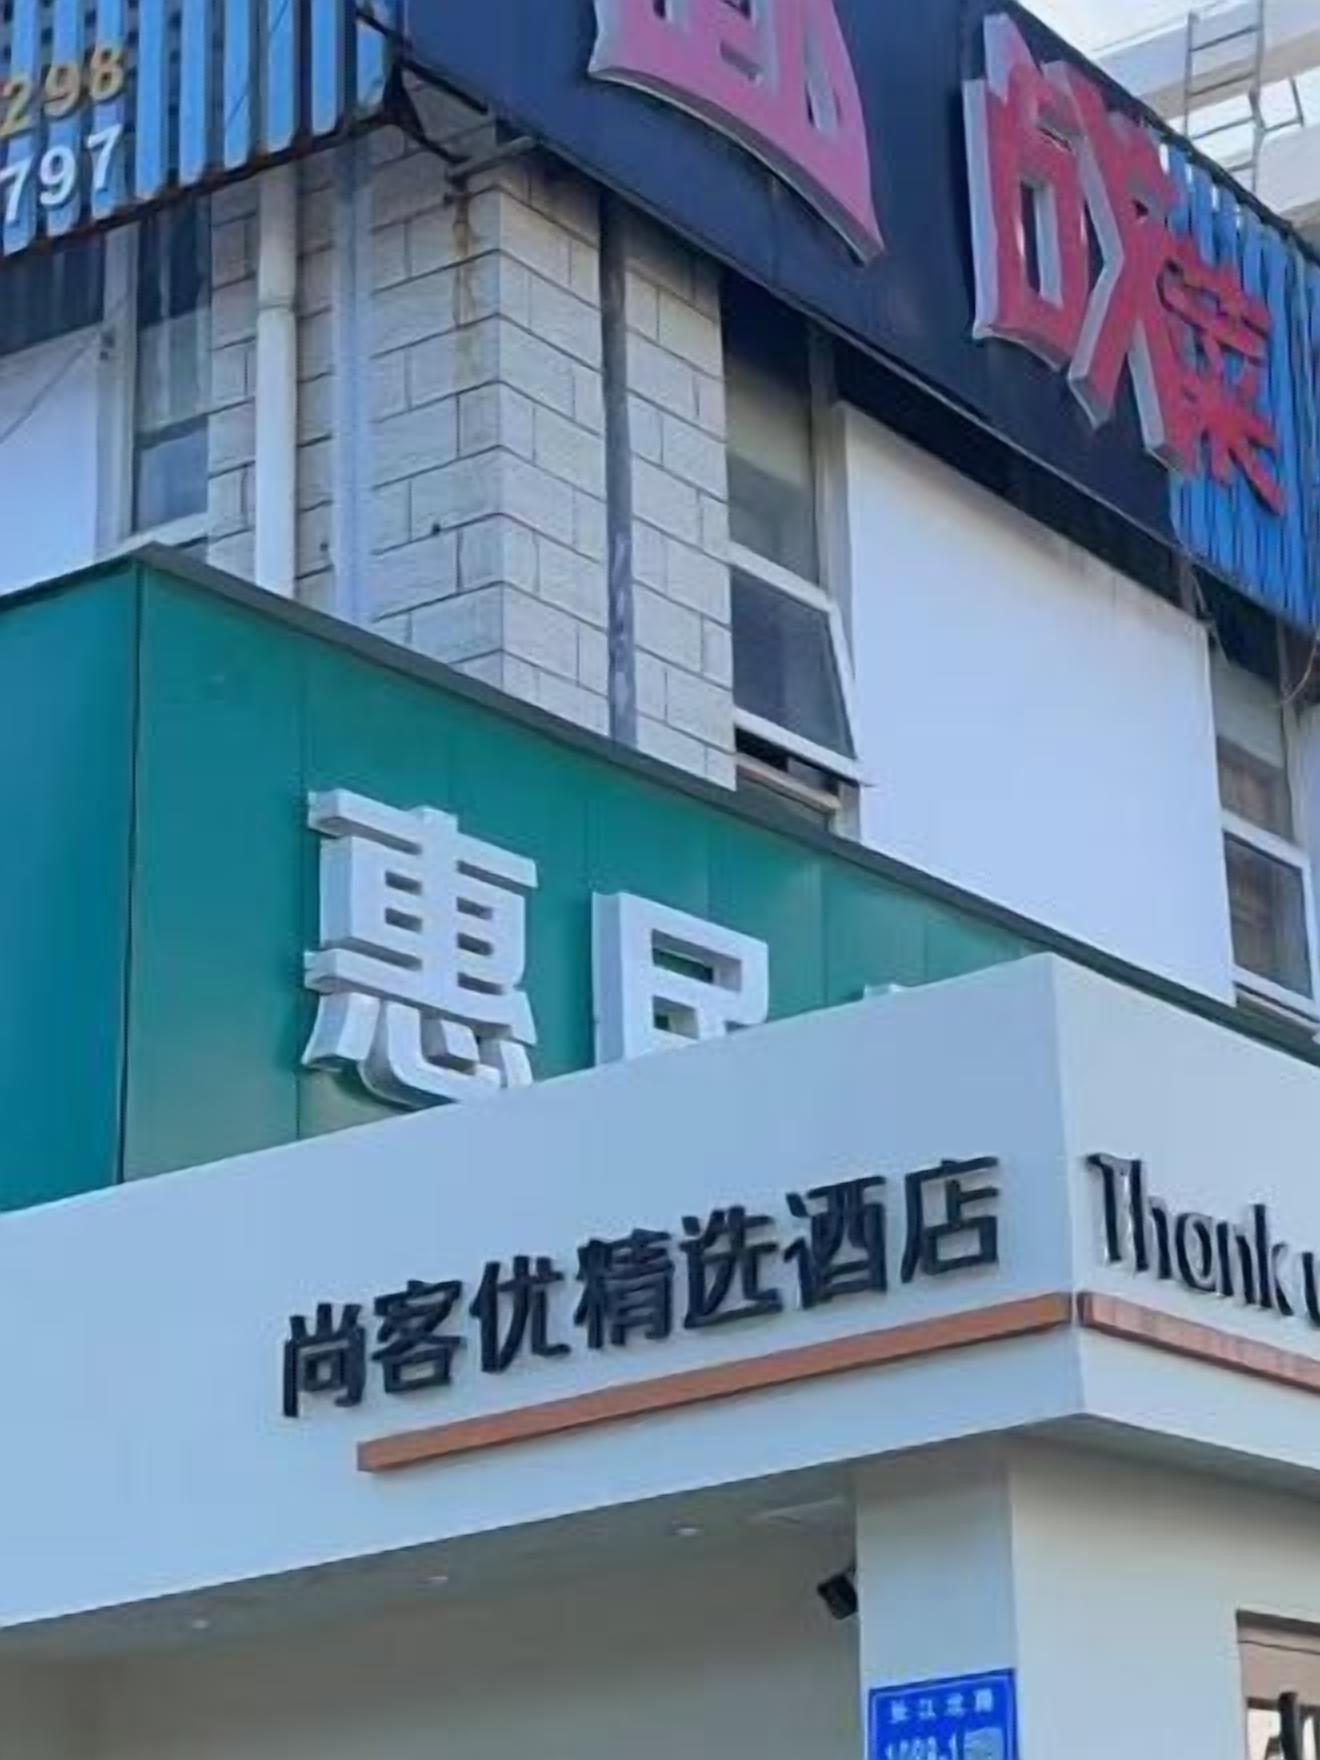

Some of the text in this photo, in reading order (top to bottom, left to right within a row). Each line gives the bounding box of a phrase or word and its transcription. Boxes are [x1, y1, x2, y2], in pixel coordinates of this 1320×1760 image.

[302, 788, 902, 1106] 惠民
[282, 1156, 999, 1417] 尚客优精选酒店
